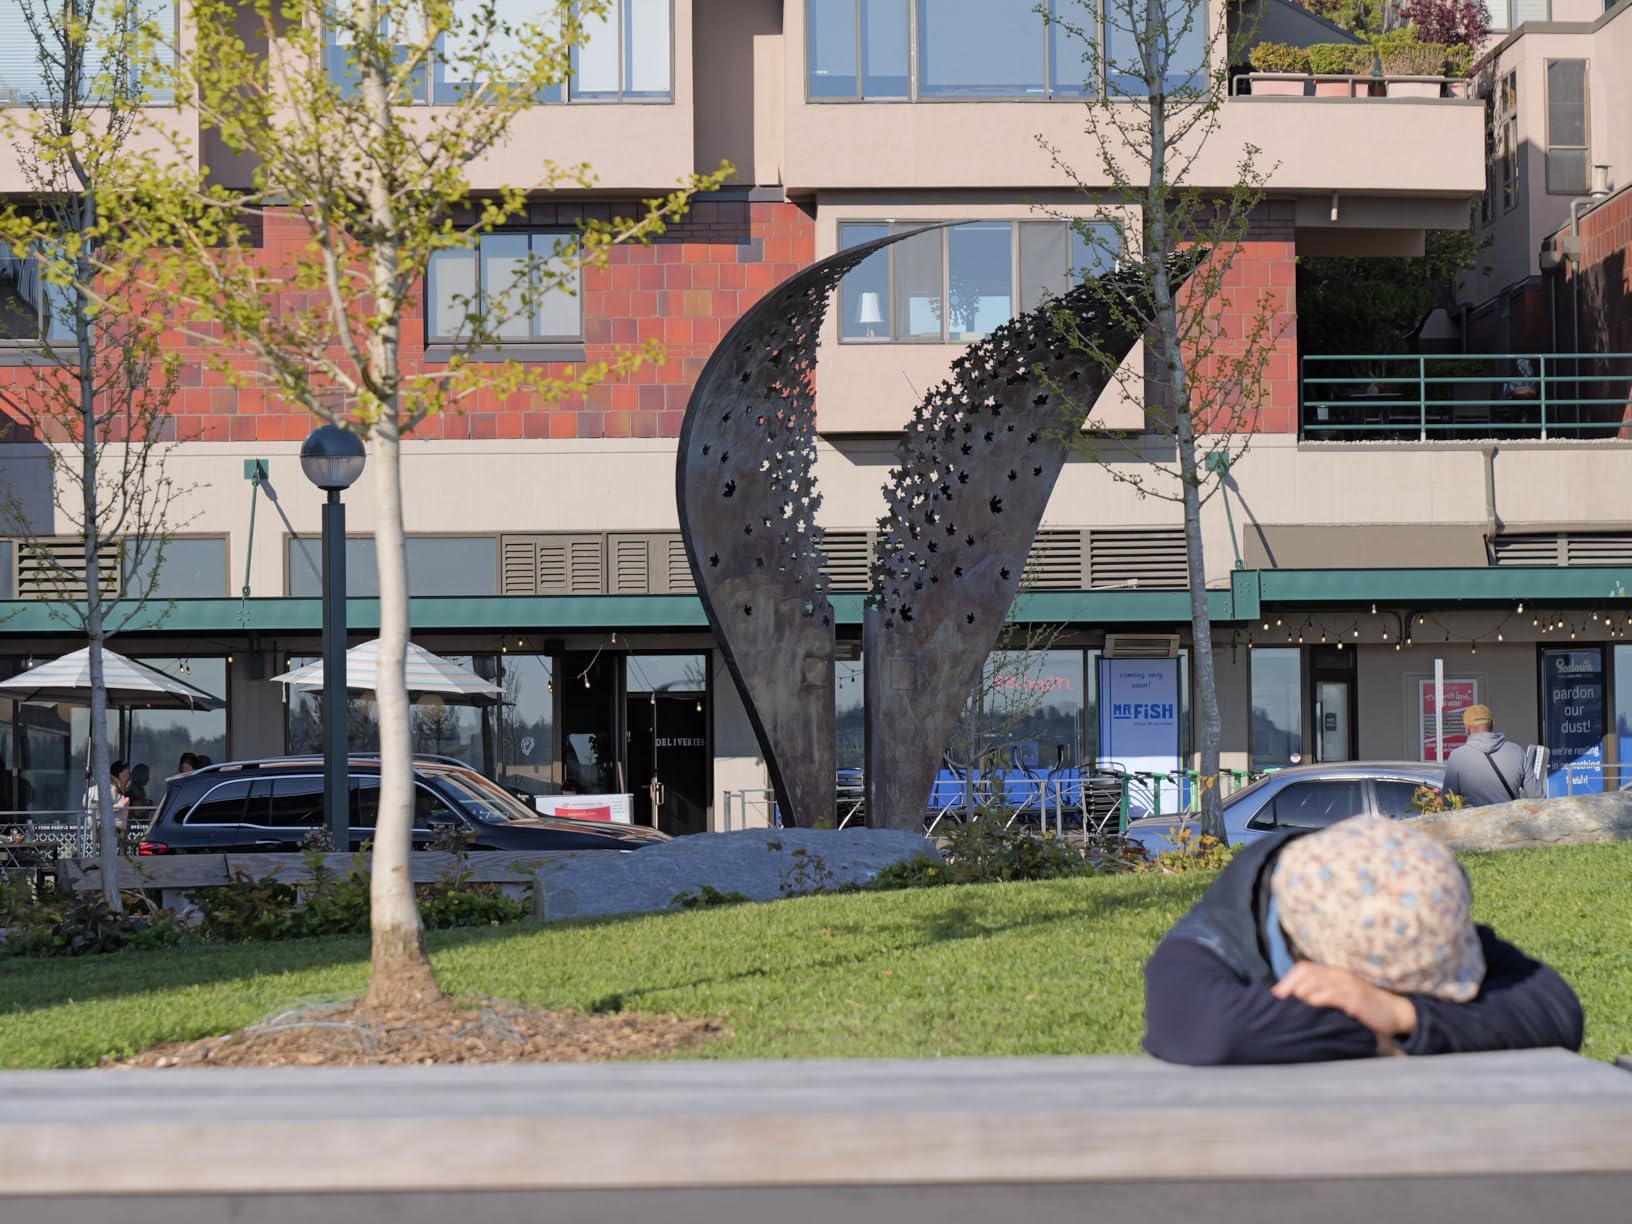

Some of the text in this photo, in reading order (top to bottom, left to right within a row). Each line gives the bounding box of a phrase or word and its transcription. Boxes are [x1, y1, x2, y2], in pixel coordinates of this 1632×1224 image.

[993, 671, 1076, 693] salmon
[1119, 671, 1164, 681] coming very
[1553, 685, 1594, 704] pardon
[1113, 703, 1132, 716] MR
[1564, 705, 1585, 717] our
[1560, 719, 1592, 734] dust!
[656, 738, 705, 747] DELIVERIES
